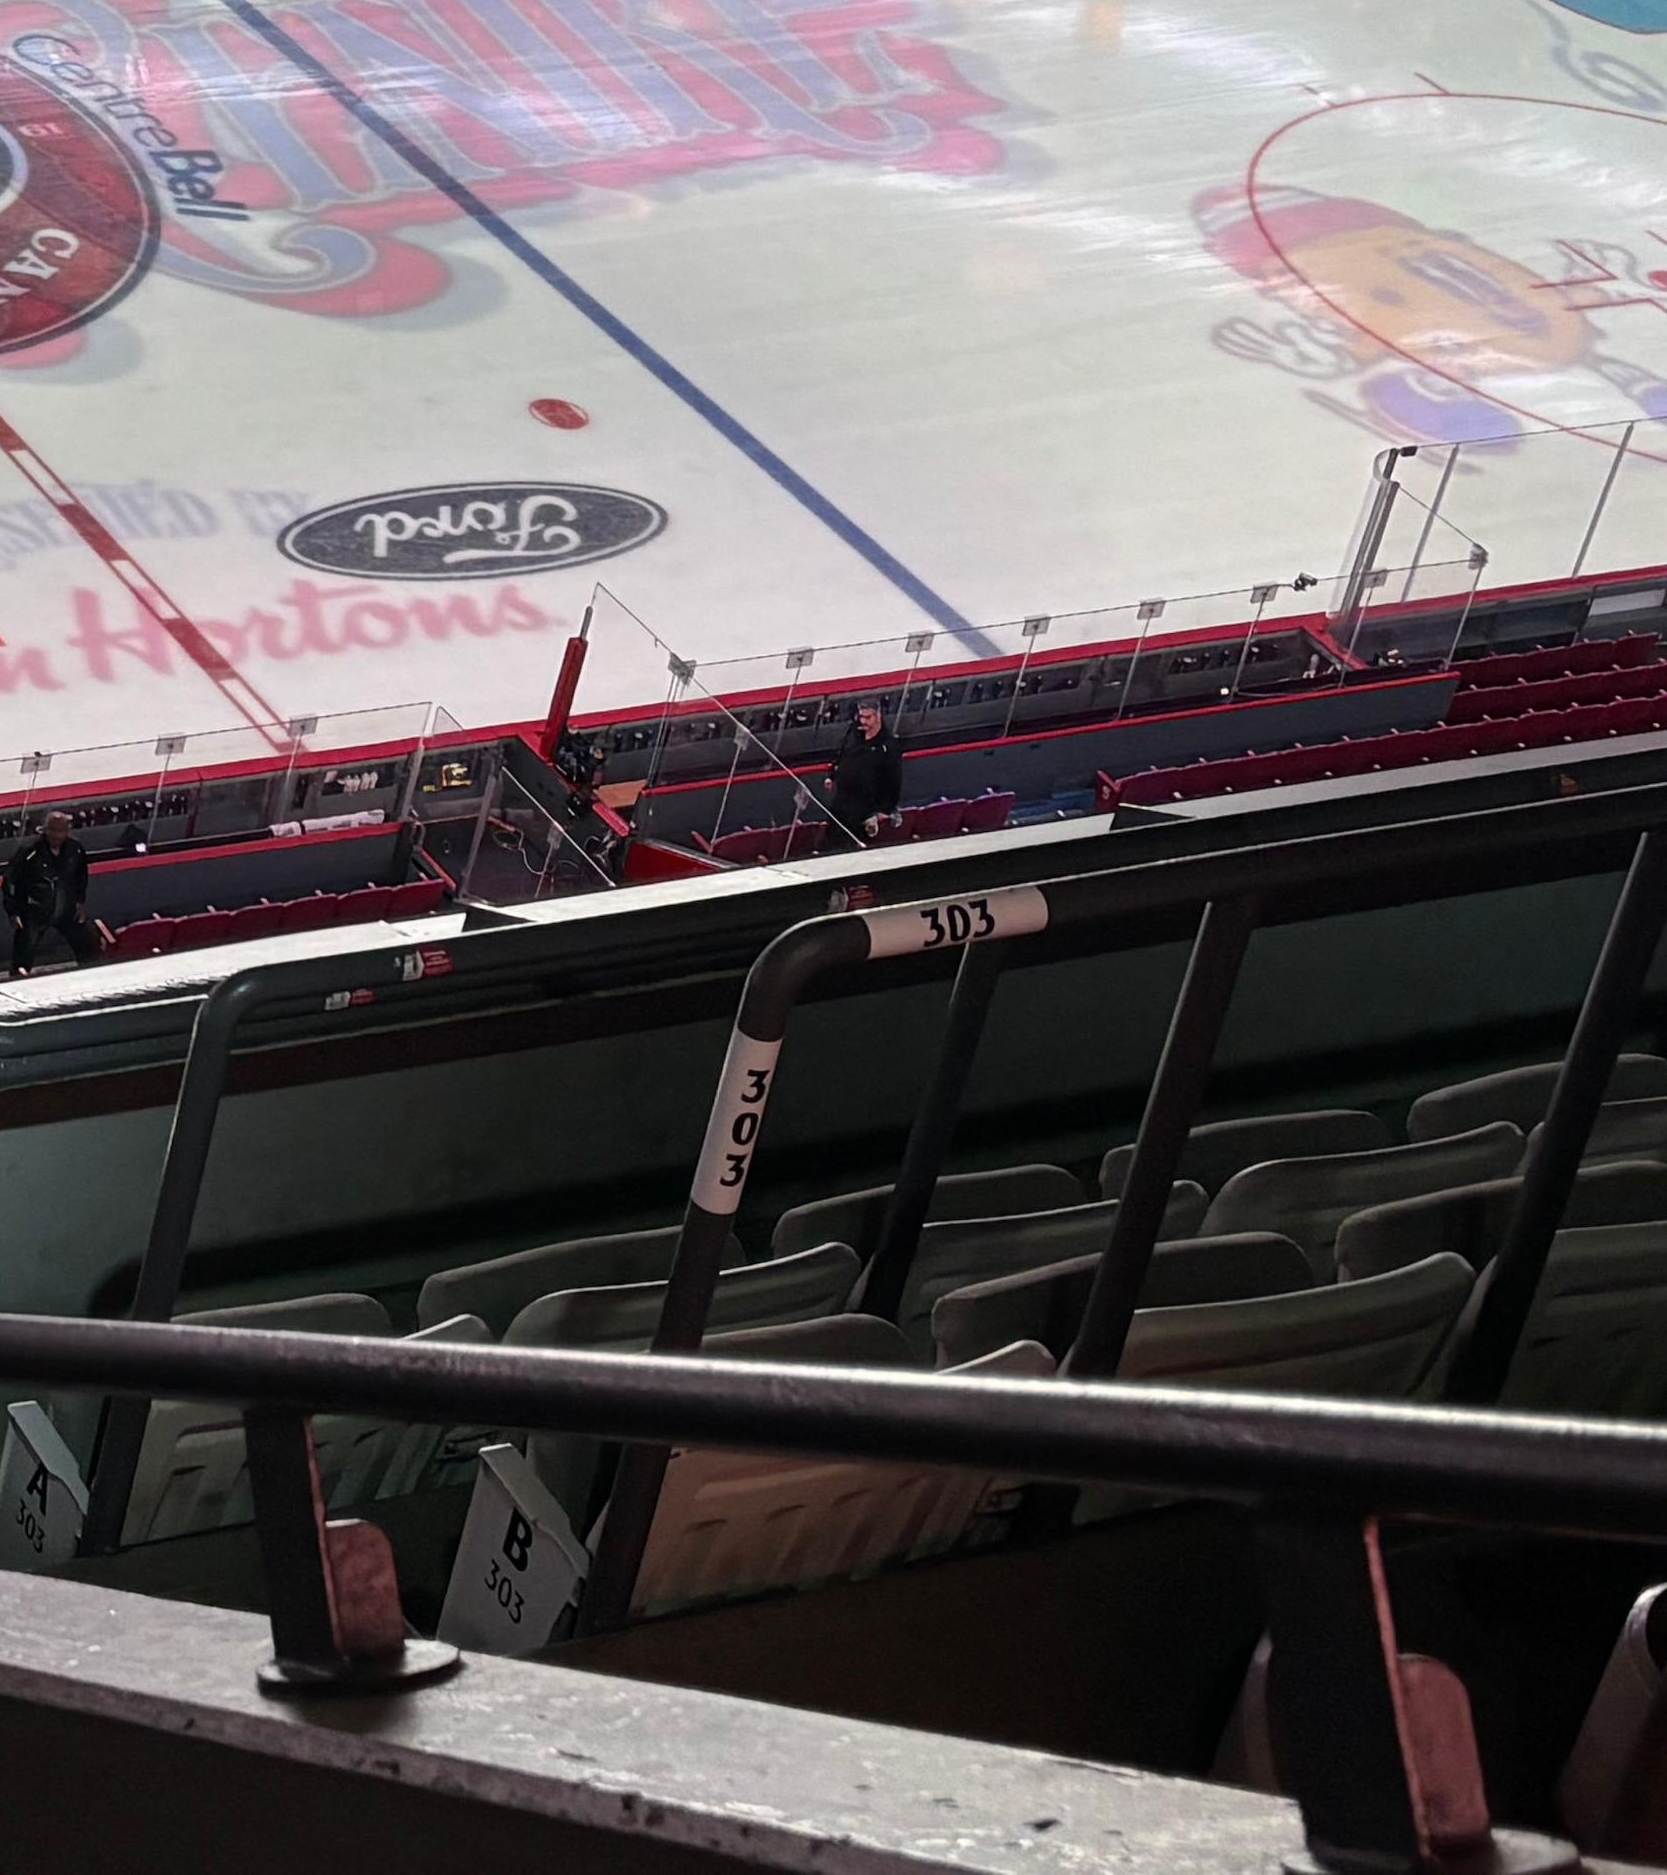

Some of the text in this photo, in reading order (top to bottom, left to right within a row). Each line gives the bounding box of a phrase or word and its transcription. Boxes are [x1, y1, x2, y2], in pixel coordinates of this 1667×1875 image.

[9, 33, 250, 223] CentreBell
[352, 495, 588, 569] Ford
[57, 577, 545, 683] Hortons
[920, 898, 997, 949] 303
[718, 1068, 771, 1188] 303
[26, 1462, 49, 1518] A
[14, 1498, 46, 1555] 303
[503, 1505, 534, 1572] B
[483, 1559, 525, 1625] 303
